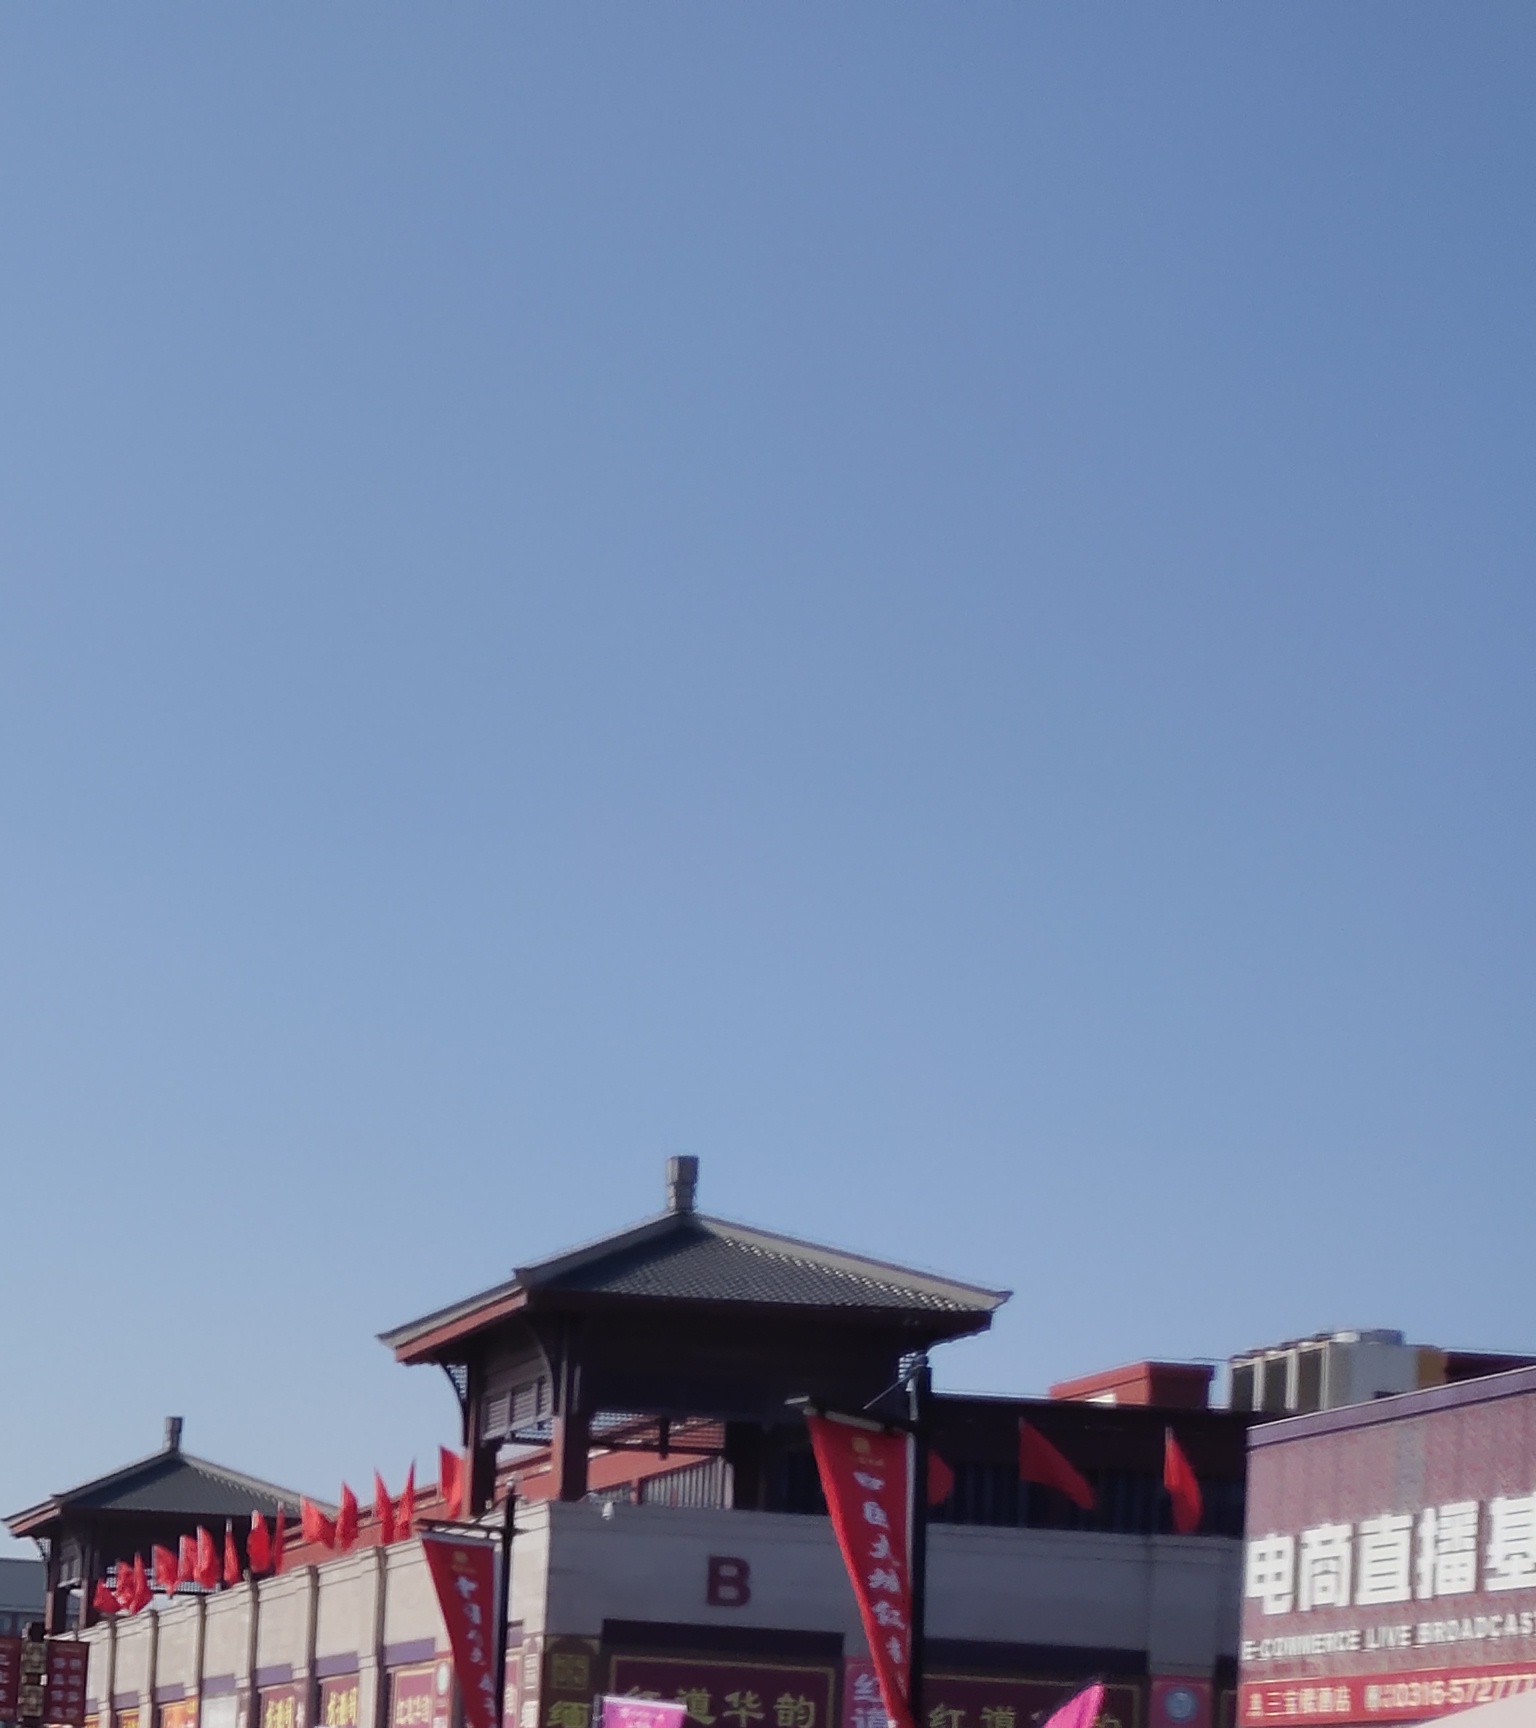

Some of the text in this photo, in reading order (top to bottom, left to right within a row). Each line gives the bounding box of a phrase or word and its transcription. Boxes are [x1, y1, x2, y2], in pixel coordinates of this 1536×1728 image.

[705, 1554, 752, 1608] B
[1245, 1492, 1536, 1616] 电商直播基
[1417, 1610, 1536, 1645] BROADCAS
